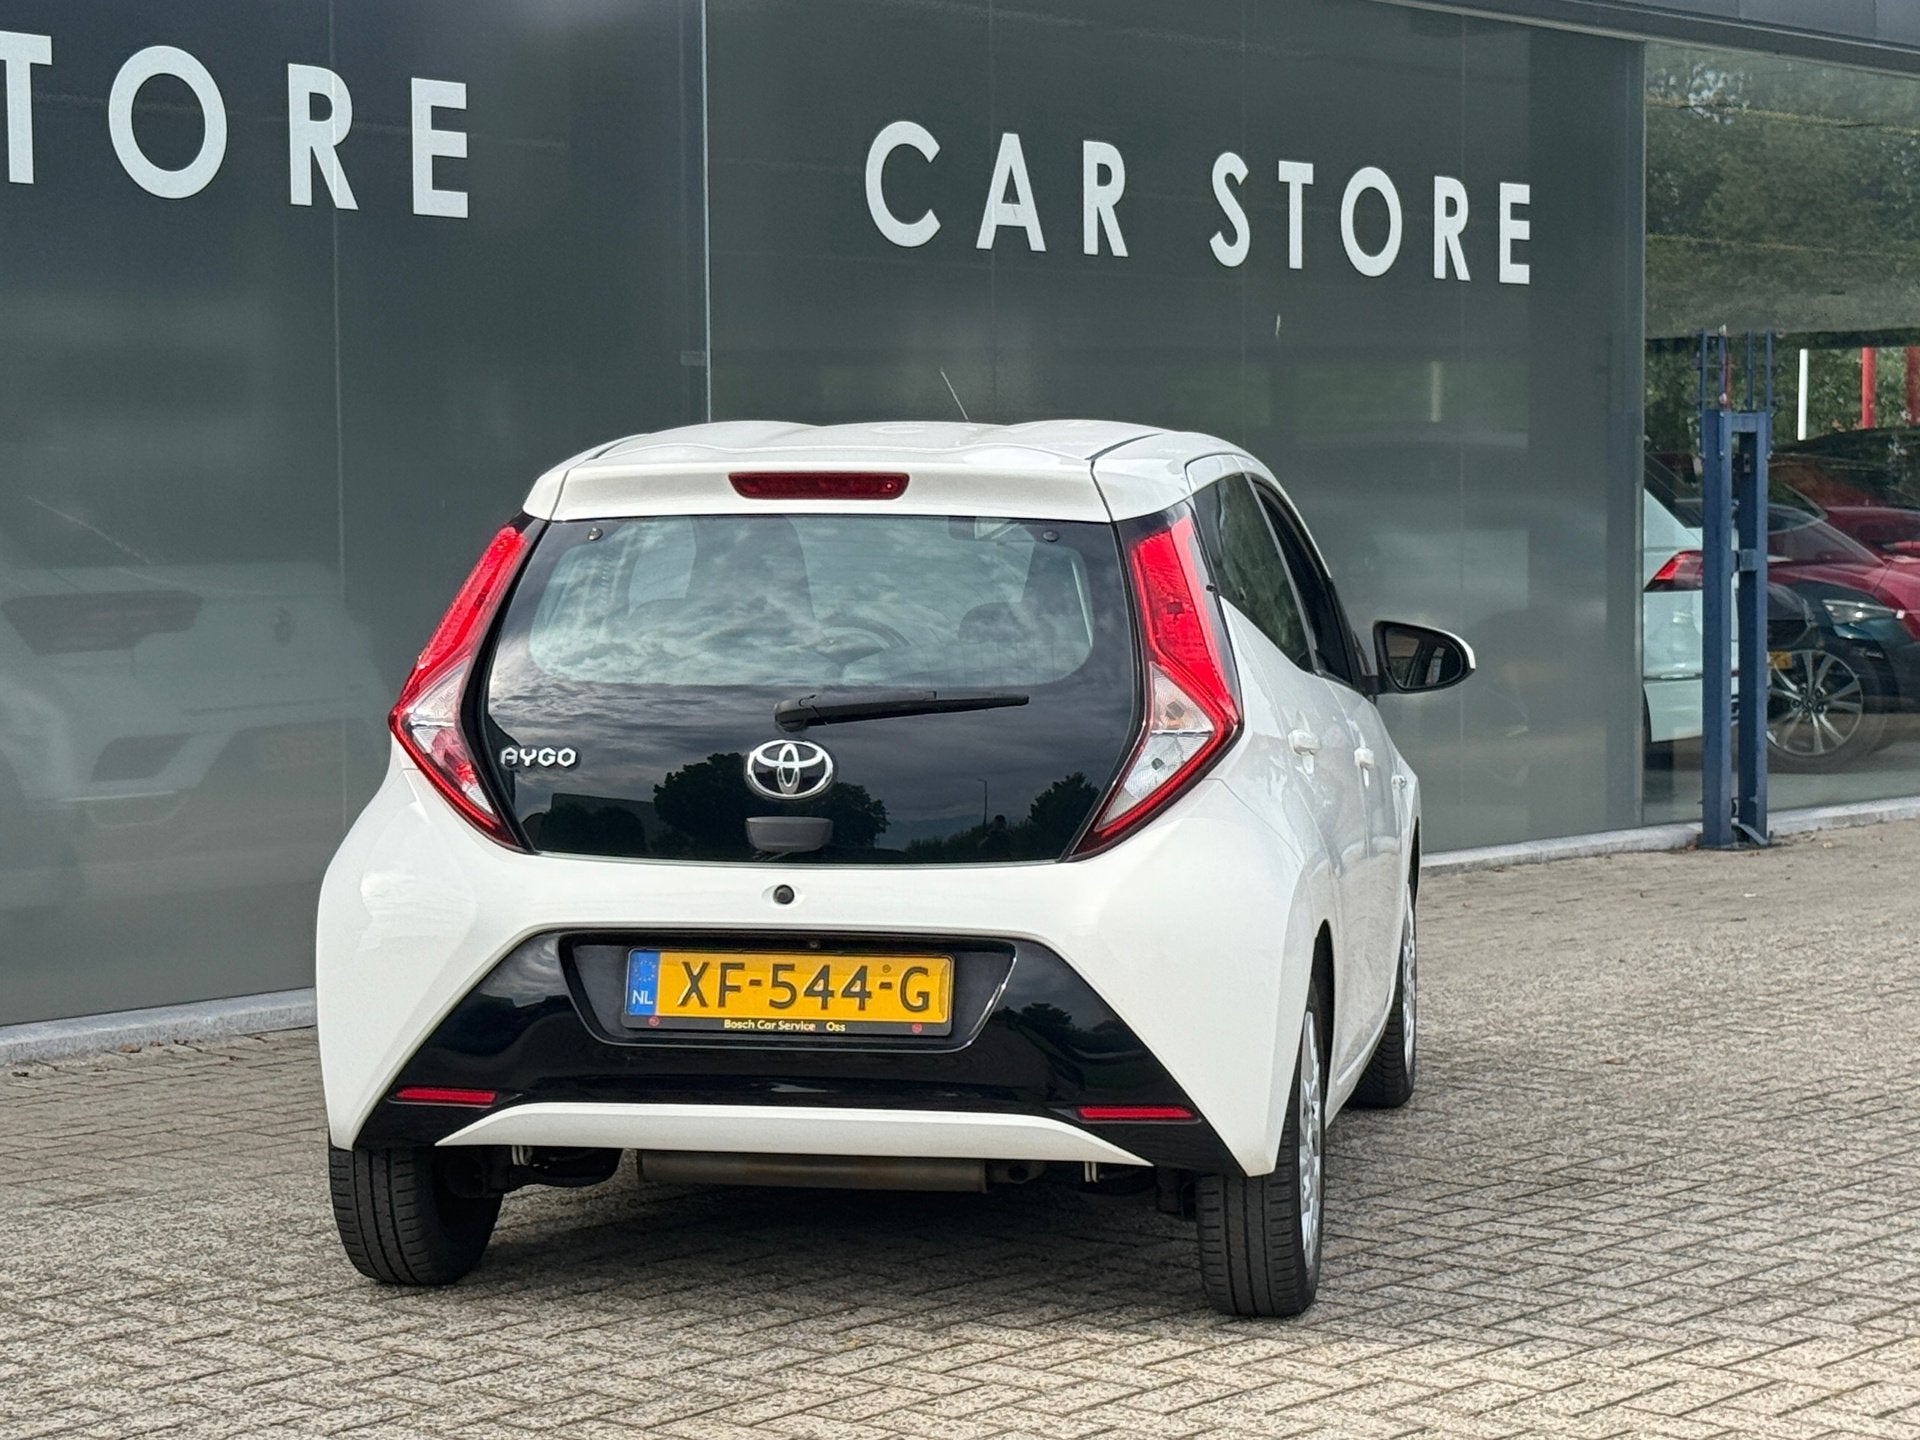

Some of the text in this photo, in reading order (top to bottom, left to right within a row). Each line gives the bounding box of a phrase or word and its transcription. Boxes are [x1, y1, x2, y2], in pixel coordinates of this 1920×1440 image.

[865, 120, 1531, 285] CAR STORE
[500, 746, 577, 768] AYGO
[677, 960, 931, 1012] XF-544-G
[631, 991, 654, 1006] NL
[724, 1019, 846, 1032] Bosch Car Service Oss
